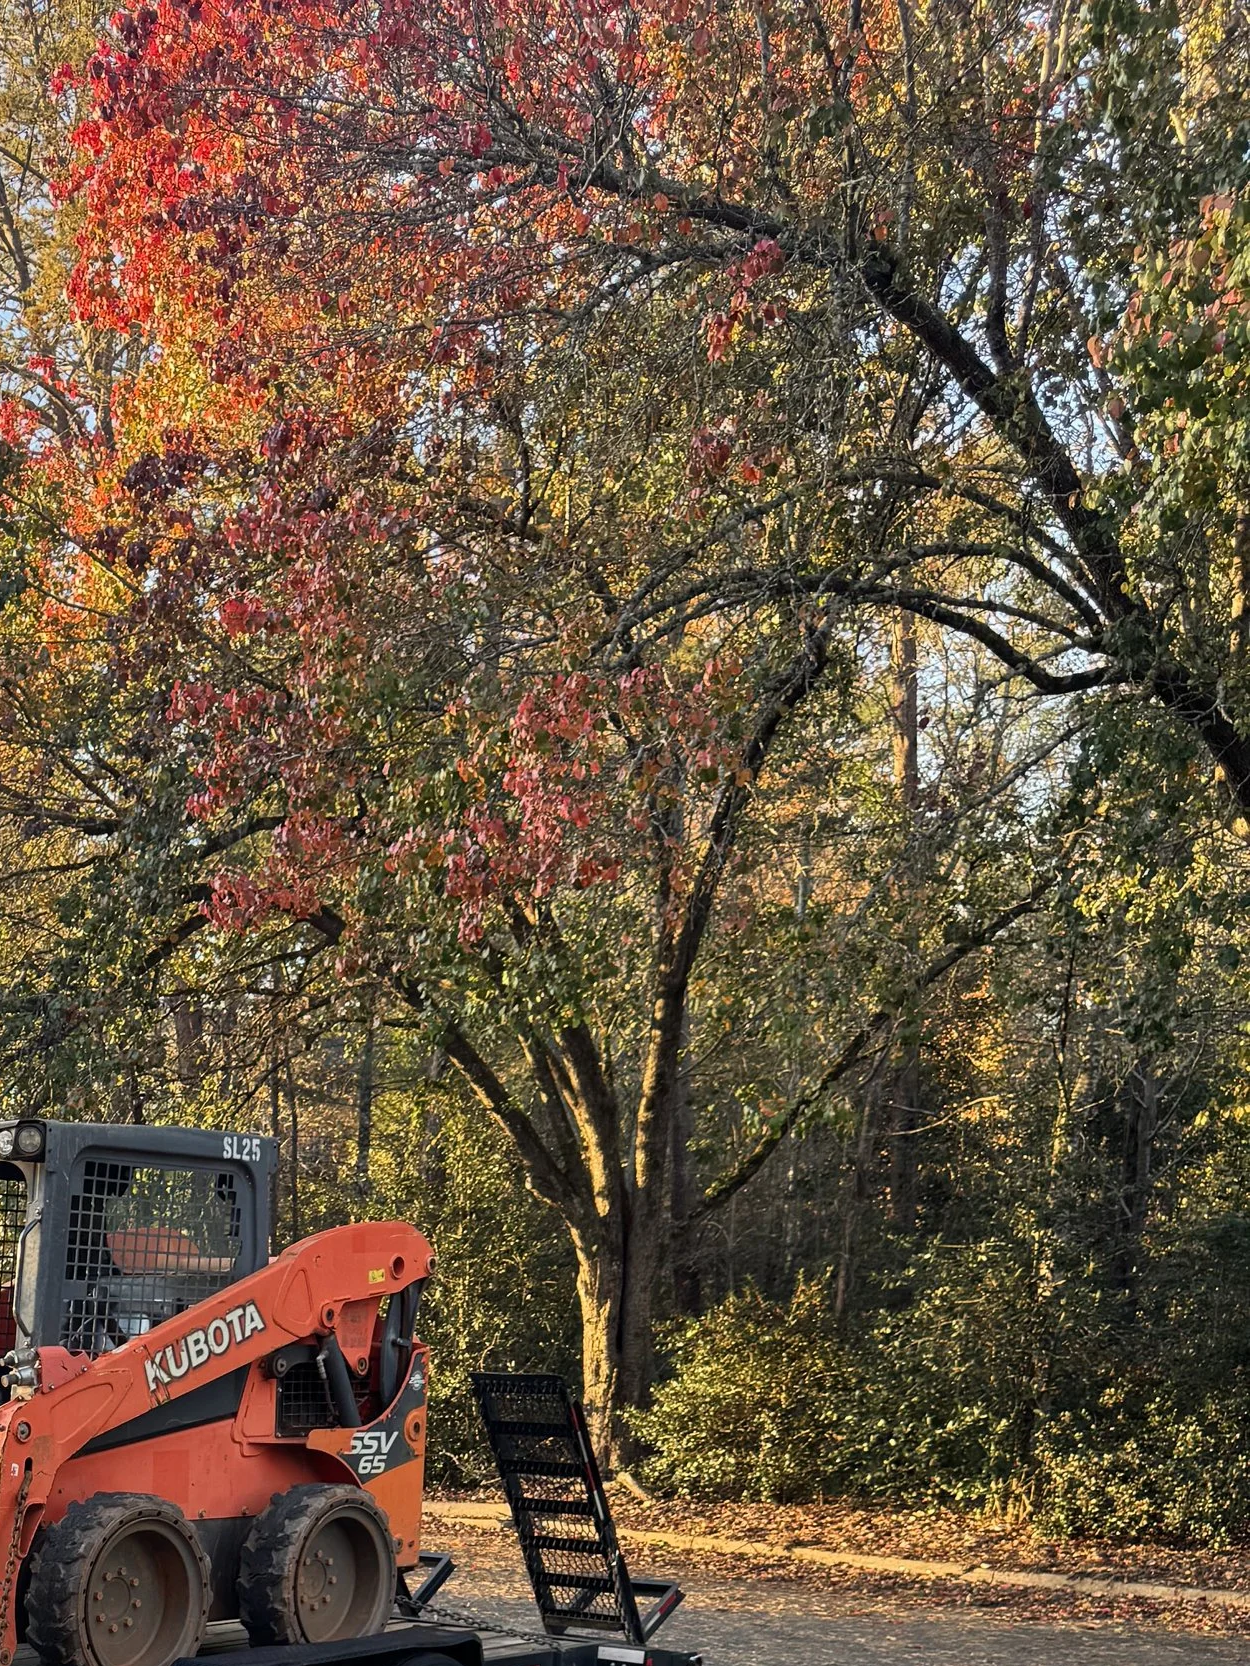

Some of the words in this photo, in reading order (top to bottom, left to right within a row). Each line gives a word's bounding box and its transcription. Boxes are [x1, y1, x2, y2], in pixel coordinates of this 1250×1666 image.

[222, 1135, 262, 1162] SL25
[143, 1300, 266, 1393] KUBOTA
[343, 1431, 400, 1455] SSV
[357, 1455, 388, 1475] 65
